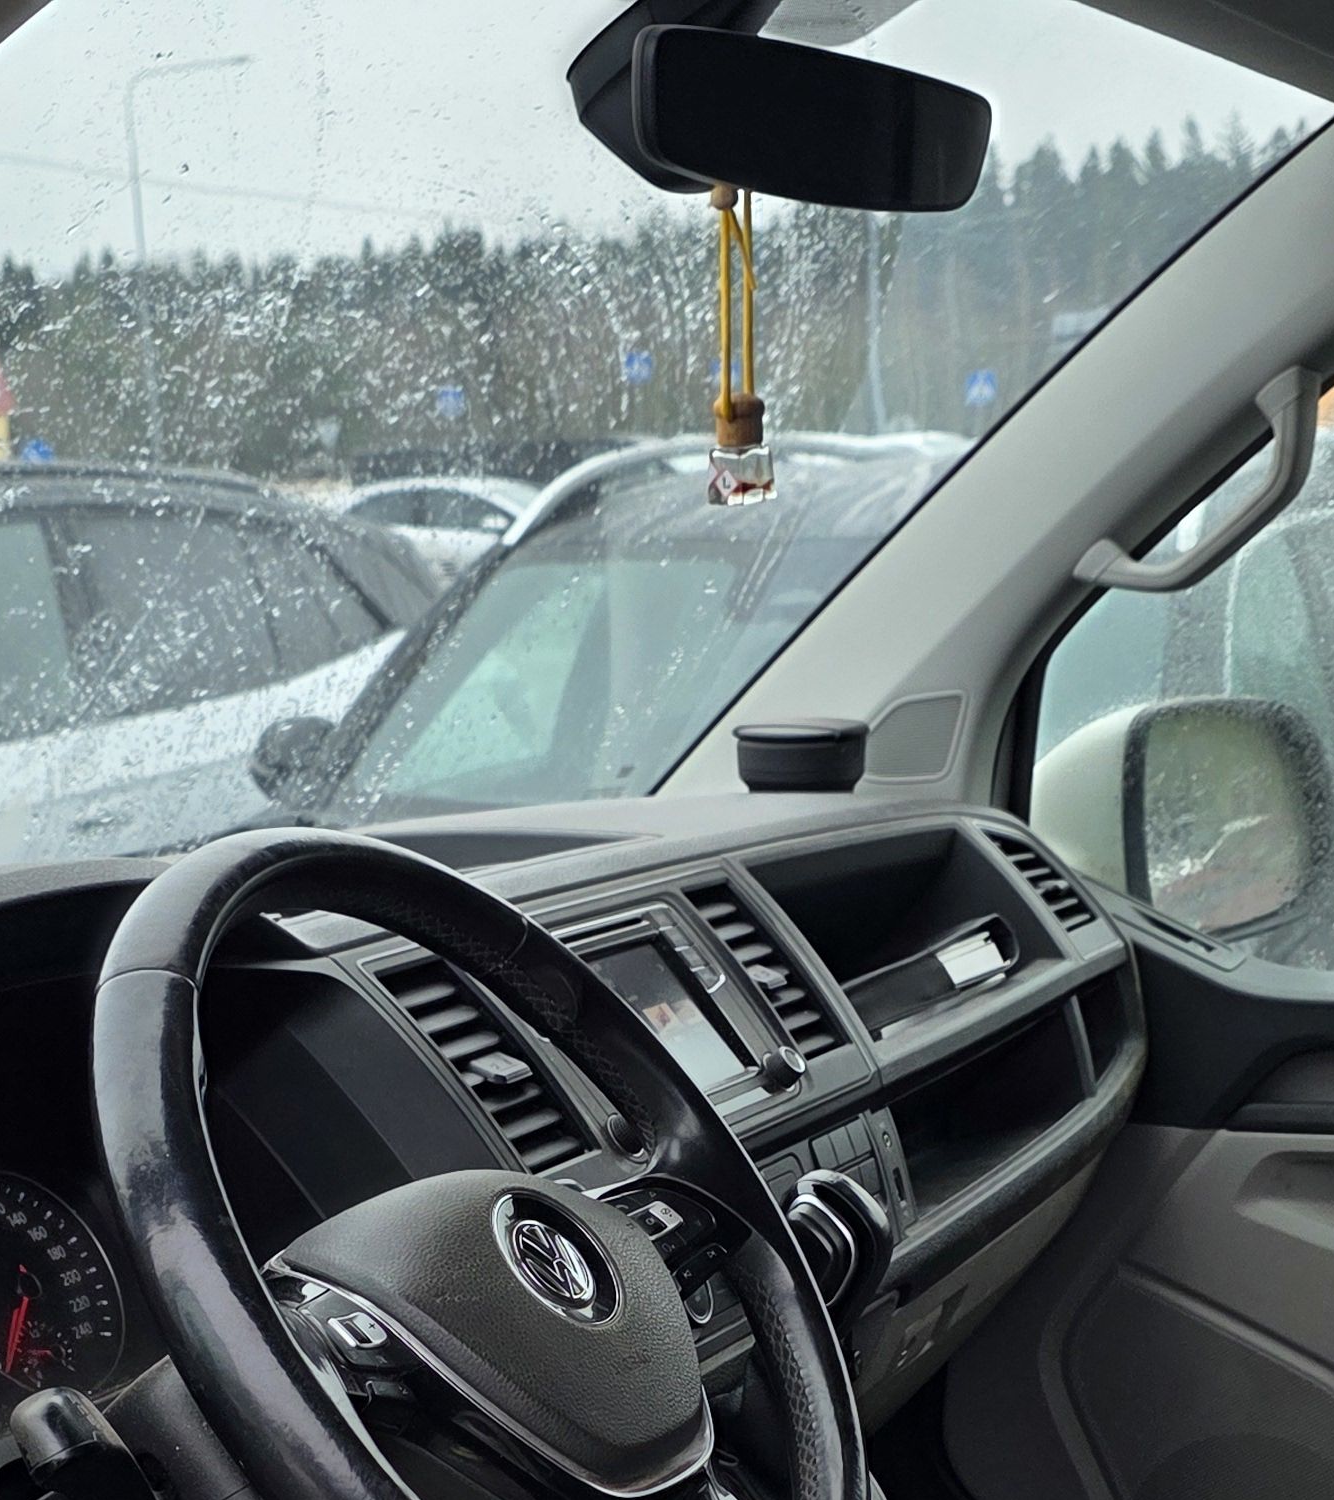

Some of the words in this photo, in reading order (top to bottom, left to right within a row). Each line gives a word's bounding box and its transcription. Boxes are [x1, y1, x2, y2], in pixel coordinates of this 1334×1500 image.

[6, 1211, 28, 1228] 140
[26, 1225, 48, 1242] 160
[47, 1244, 67, 1261] 180
[60, 1268, 82, 1286] 200
[69, 1295, 91, 1313] 220
[71, 1321, 93, 1339] 240
